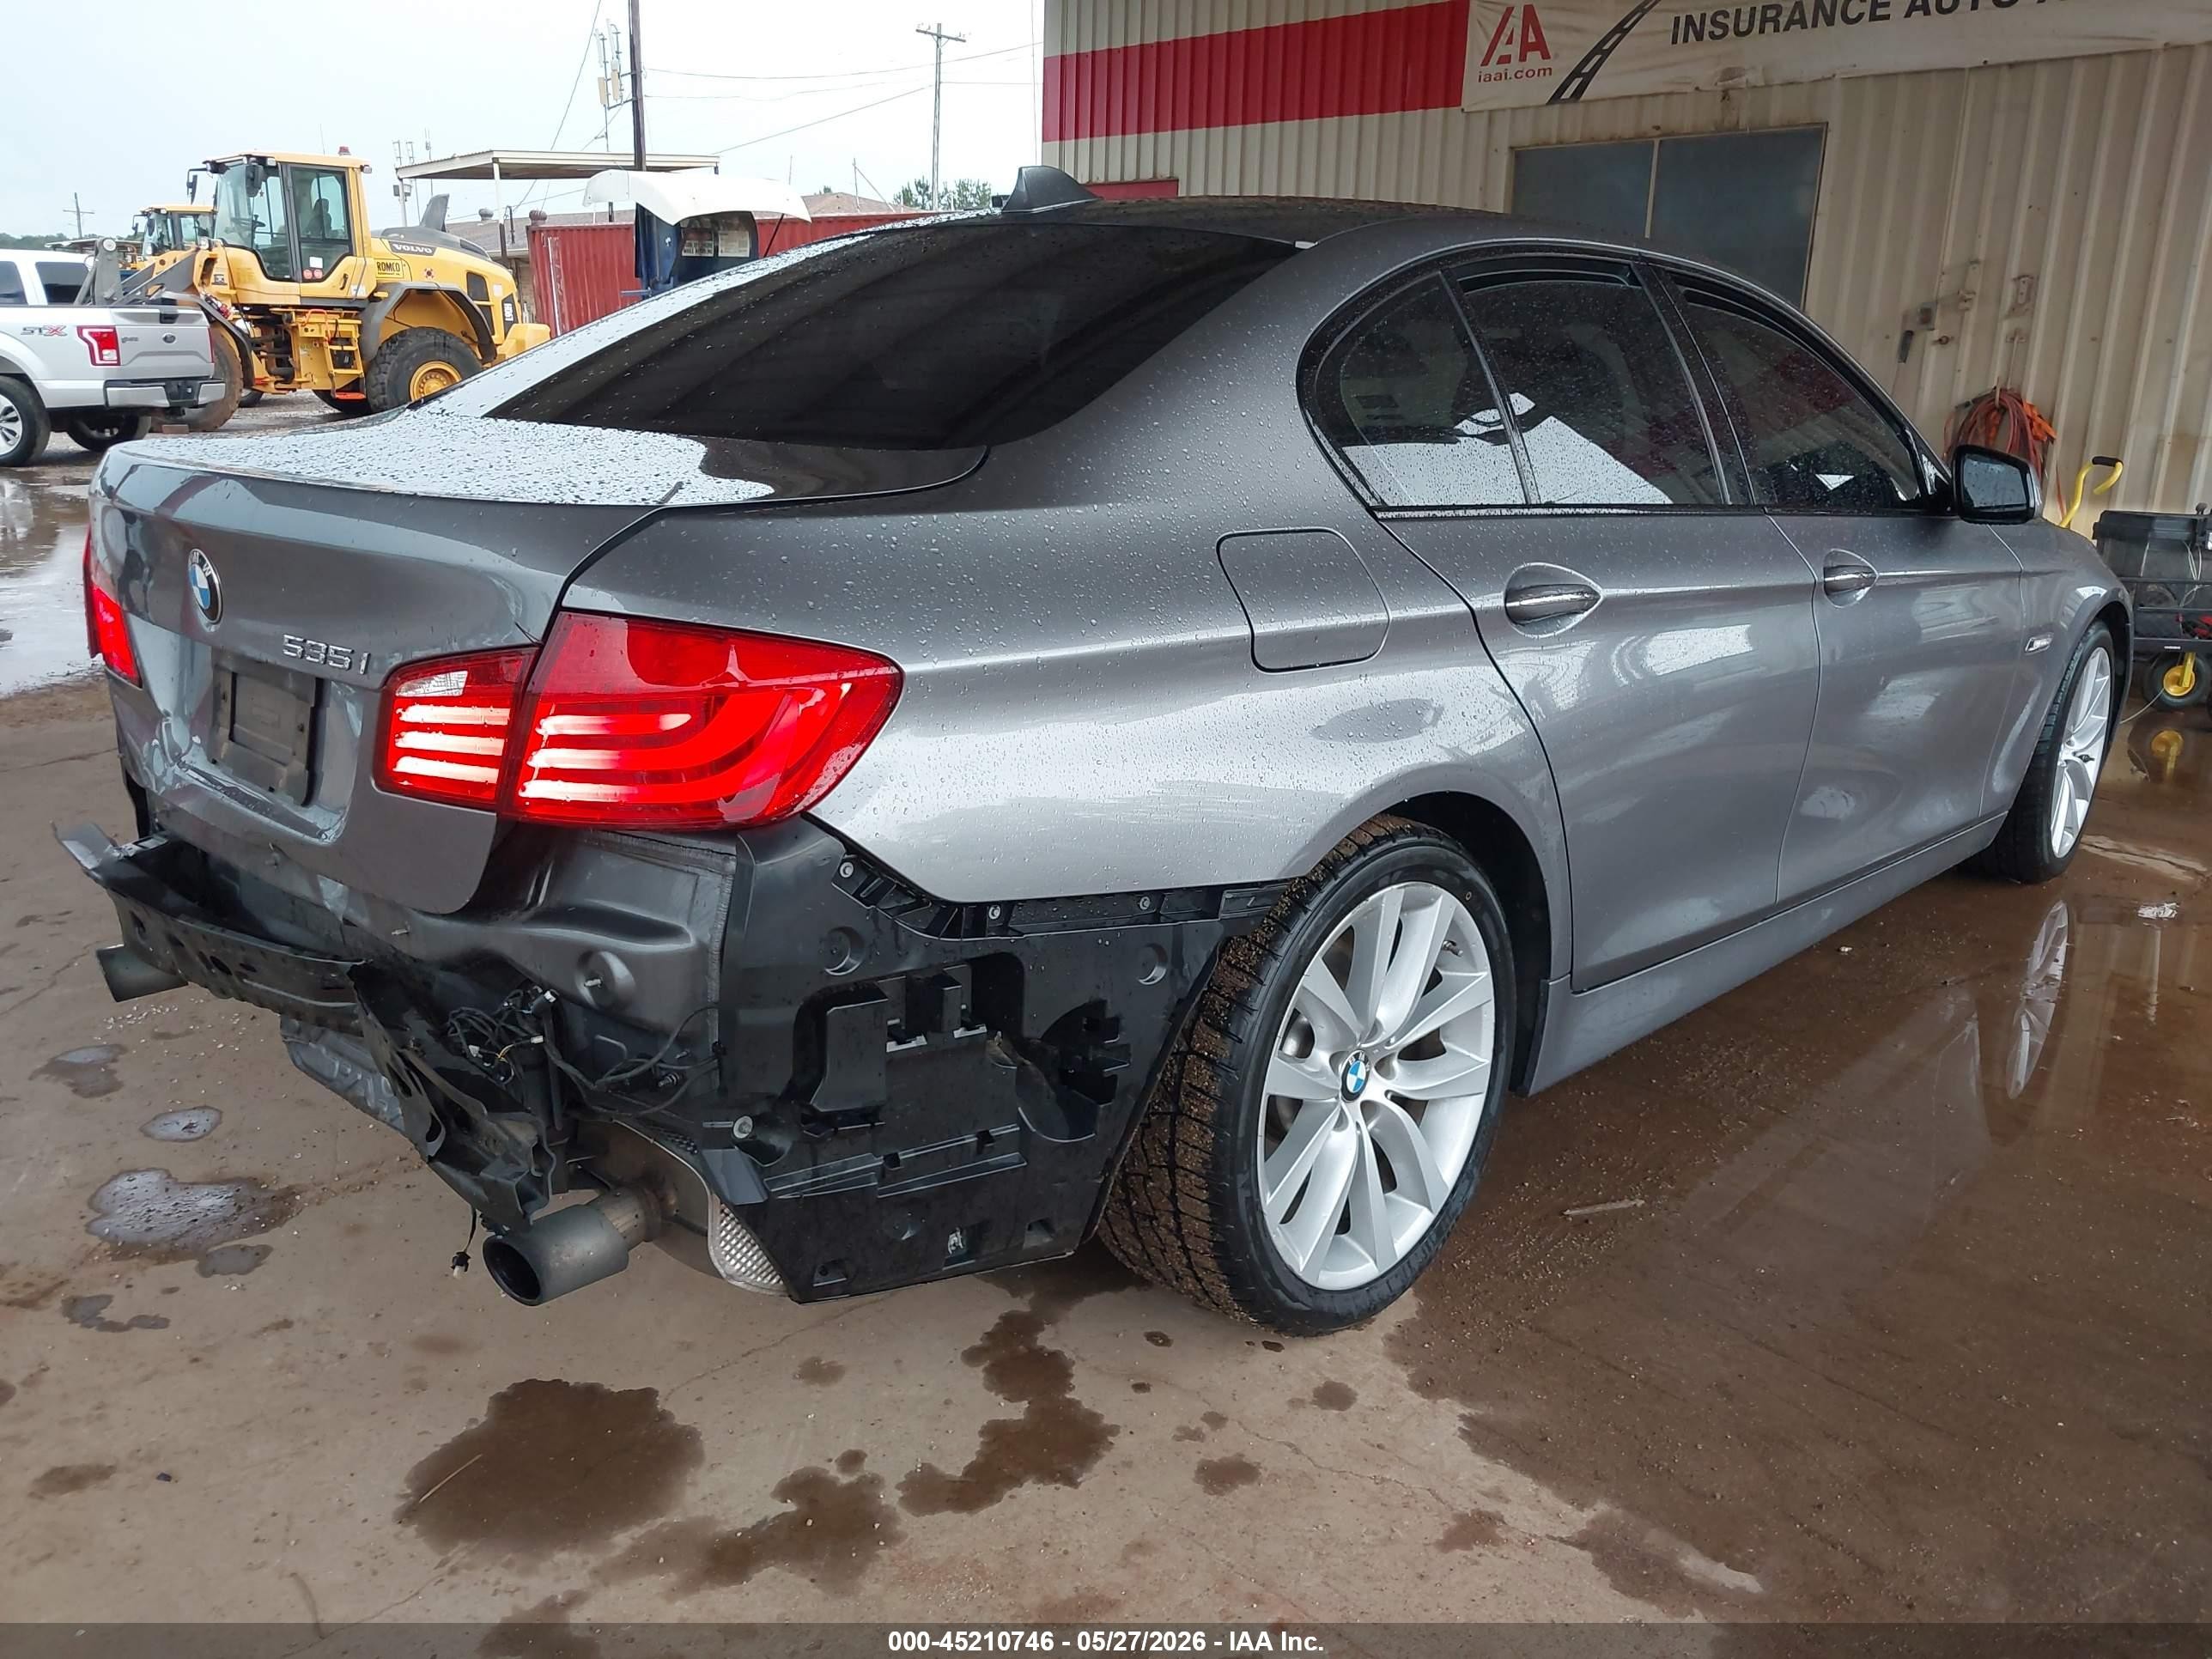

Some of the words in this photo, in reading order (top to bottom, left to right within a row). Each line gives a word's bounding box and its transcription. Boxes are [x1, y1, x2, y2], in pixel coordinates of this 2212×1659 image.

[1671, 0, 1891, 45] INSURANCE
[1478, 67, 1553, 82] iaai.com
[392, 243, 433, 254] VOLVO
[376, 261, 401, 272] ROMCO
[21, 325, 68, 337] STX
